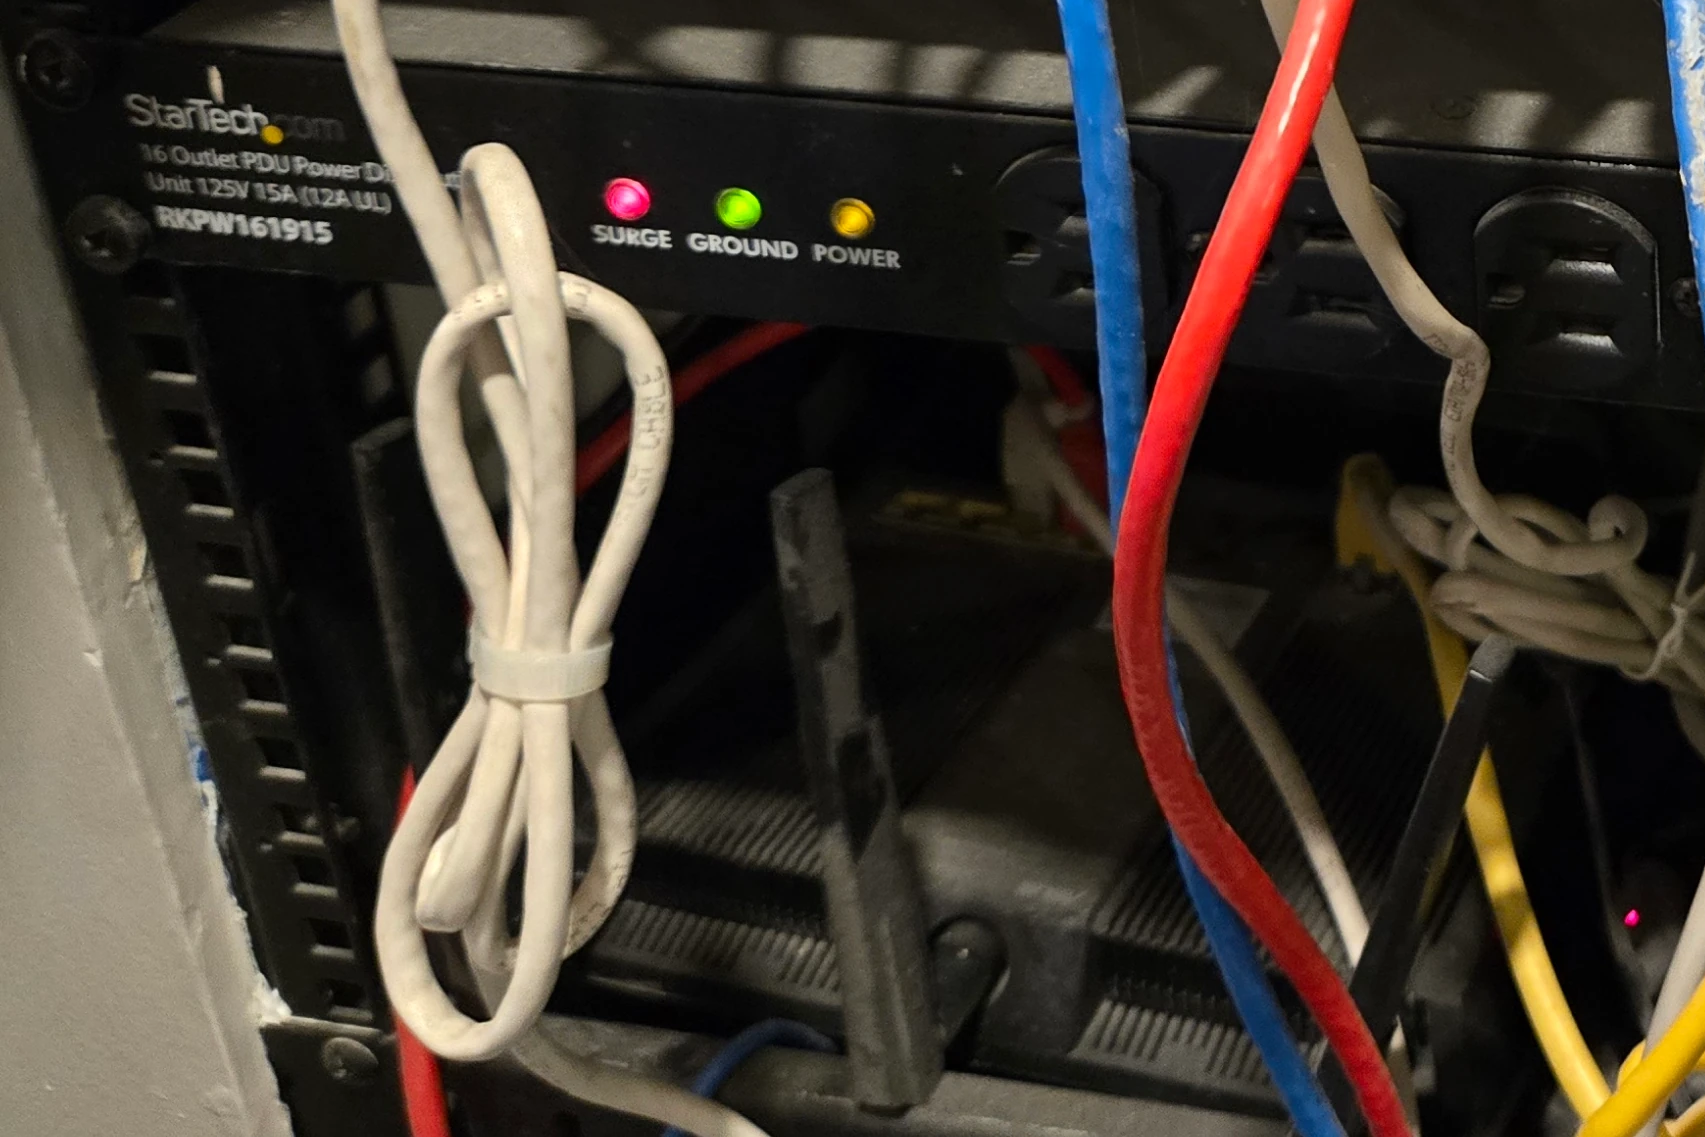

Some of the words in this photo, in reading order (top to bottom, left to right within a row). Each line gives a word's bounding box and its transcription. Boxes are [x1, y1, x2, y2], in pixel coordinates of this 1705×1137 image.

[171, 145, 240, 170] Outlet
[241, 150, 291, 175] PDU
[294, 155, 362, 182] Power
[145, 170, 195, 194] Unit
[199, 177, 249, 200] 125V
[255, 182, 299, 204] 15A
[354, 190, 392, 215] UL)
[152, 204, 334, 245] RKPW161915
[590, 223, 673, 250] SURGE
[685, 232, 800, 261] GROUND
[811, 243, 901, 269] POWER
